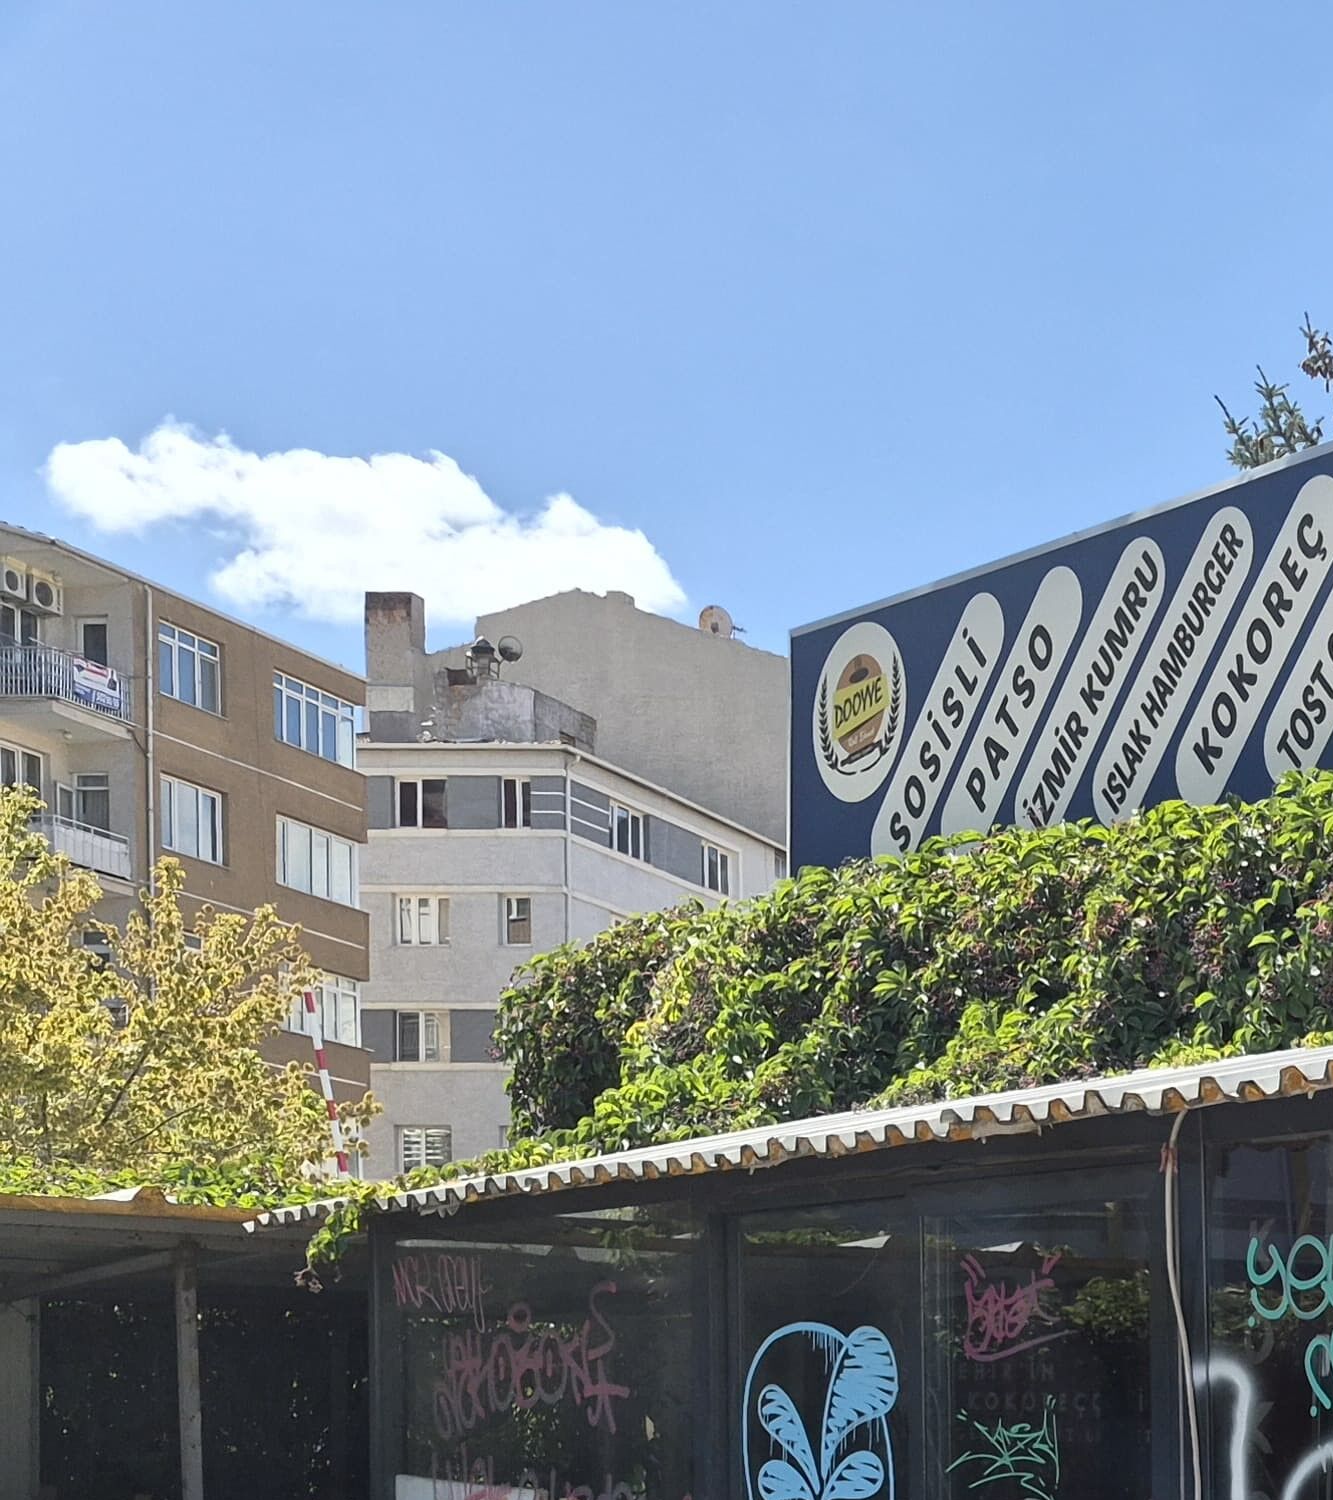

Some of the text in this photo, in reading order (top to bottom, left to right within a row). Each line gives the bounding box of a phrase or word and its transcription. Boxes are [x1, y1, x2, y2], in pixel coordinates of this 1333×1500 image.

[890, 627, 987, 852] SOSİSLİ
[965, 624, 1053, 813] PATSO
[1022, 550, 1158, 830] İZMİR KUMRU
[1101, 523, 1244, 815] ISLAK HAMBURGER
[1193, 513, 1328, 776] KOKOREÇ
